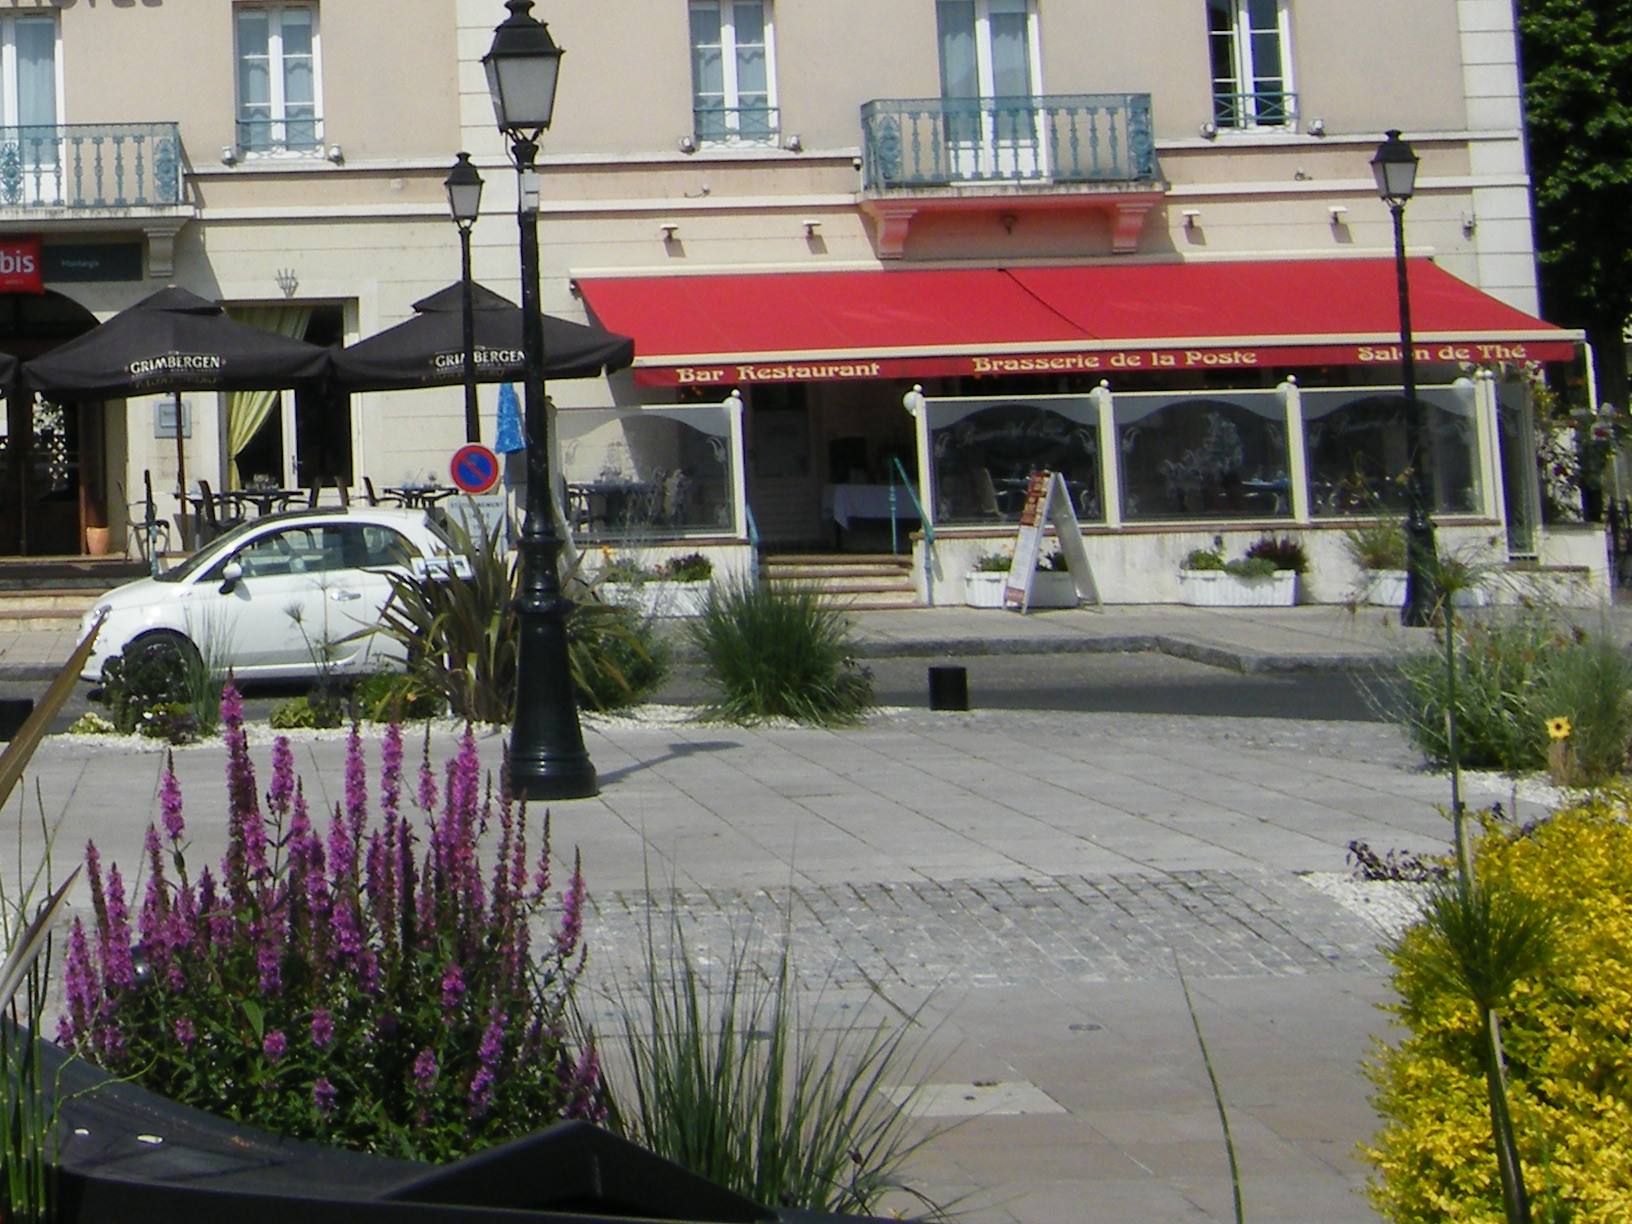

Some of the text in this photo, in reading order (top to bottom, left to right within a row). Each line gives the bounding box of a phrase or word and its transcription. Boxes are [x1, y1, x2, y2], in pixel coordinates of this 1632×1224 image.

[972, 350, 1258, 373] Brasserie de la Poste
[1358, 344, 1526, 362] Saln de Thé
[130, 356, 220, 373] GRIMBERGEN
[675, 362, 880, 383] Bar Restaurant
